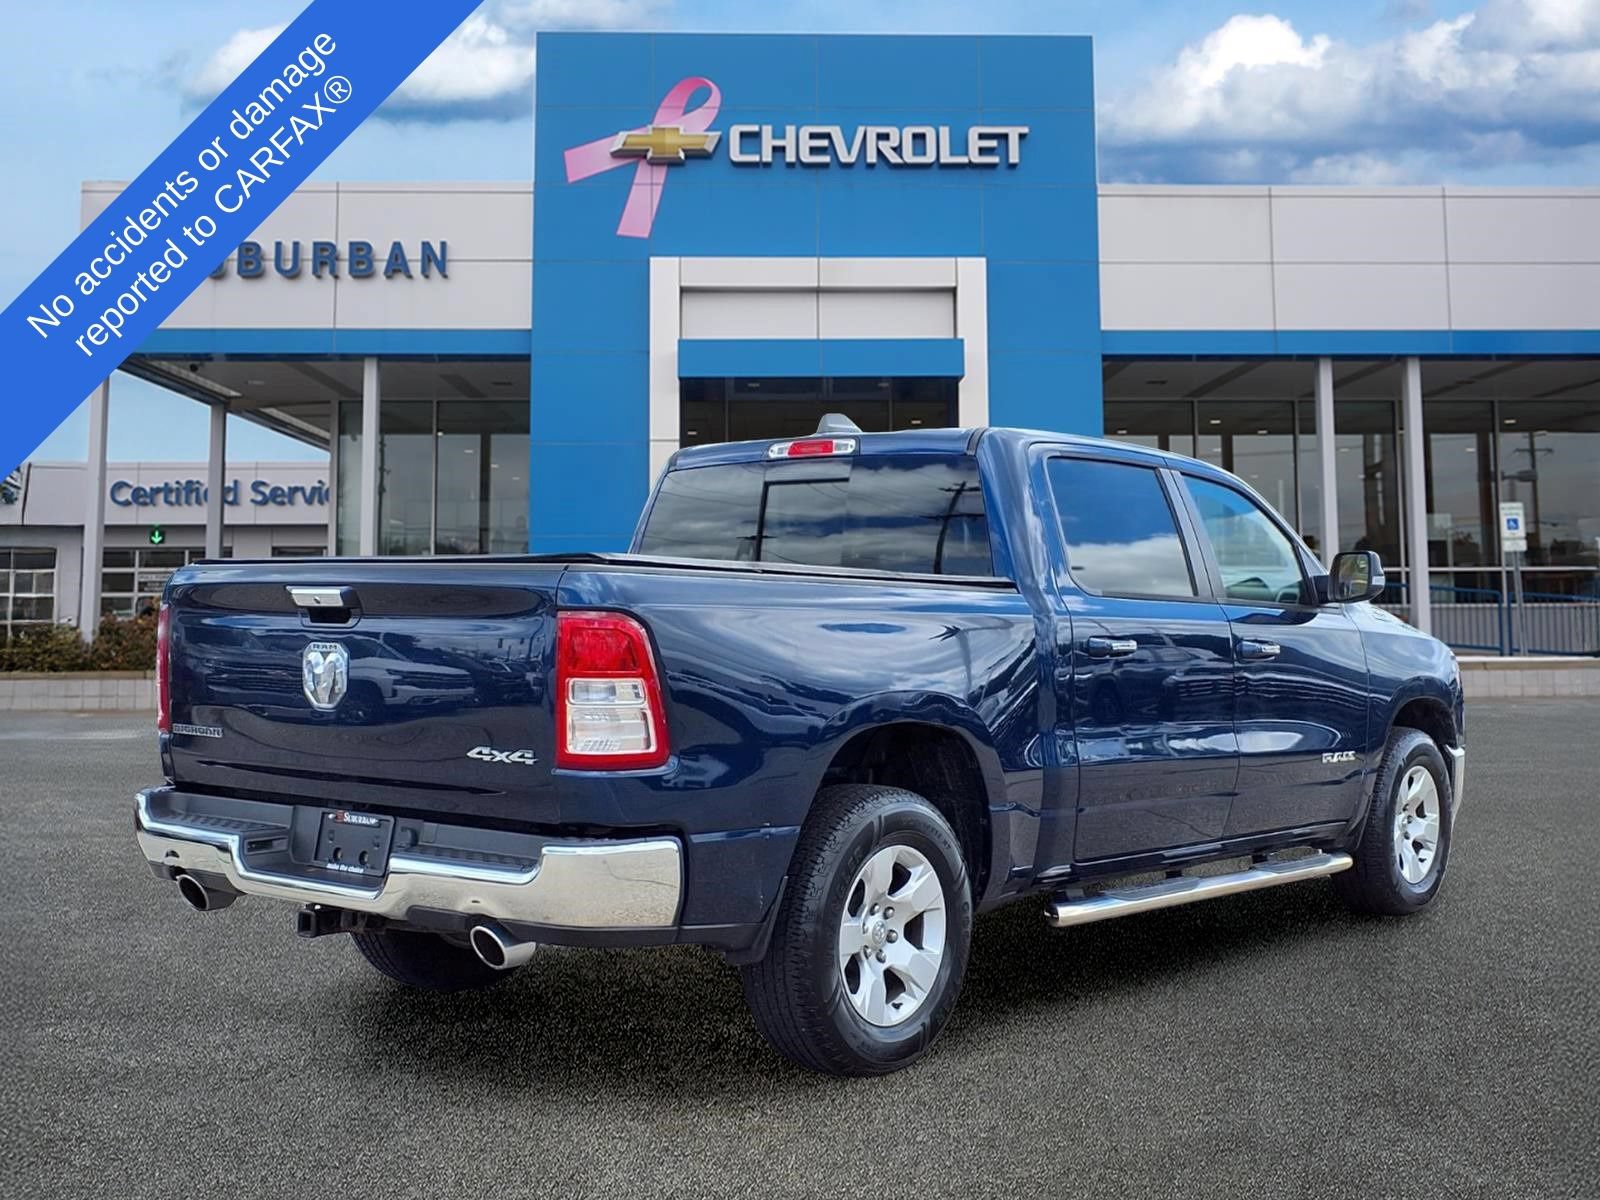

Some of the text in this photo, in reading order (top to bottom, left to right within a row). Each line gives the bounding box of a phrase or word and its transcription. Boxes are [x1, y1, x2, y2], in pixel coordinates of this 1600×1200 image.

[728, 124, 1030, 165] CHEVROLET
[110, 479, 330, 506] Certifid Servi
[312, 643, 338, 651] RAM
